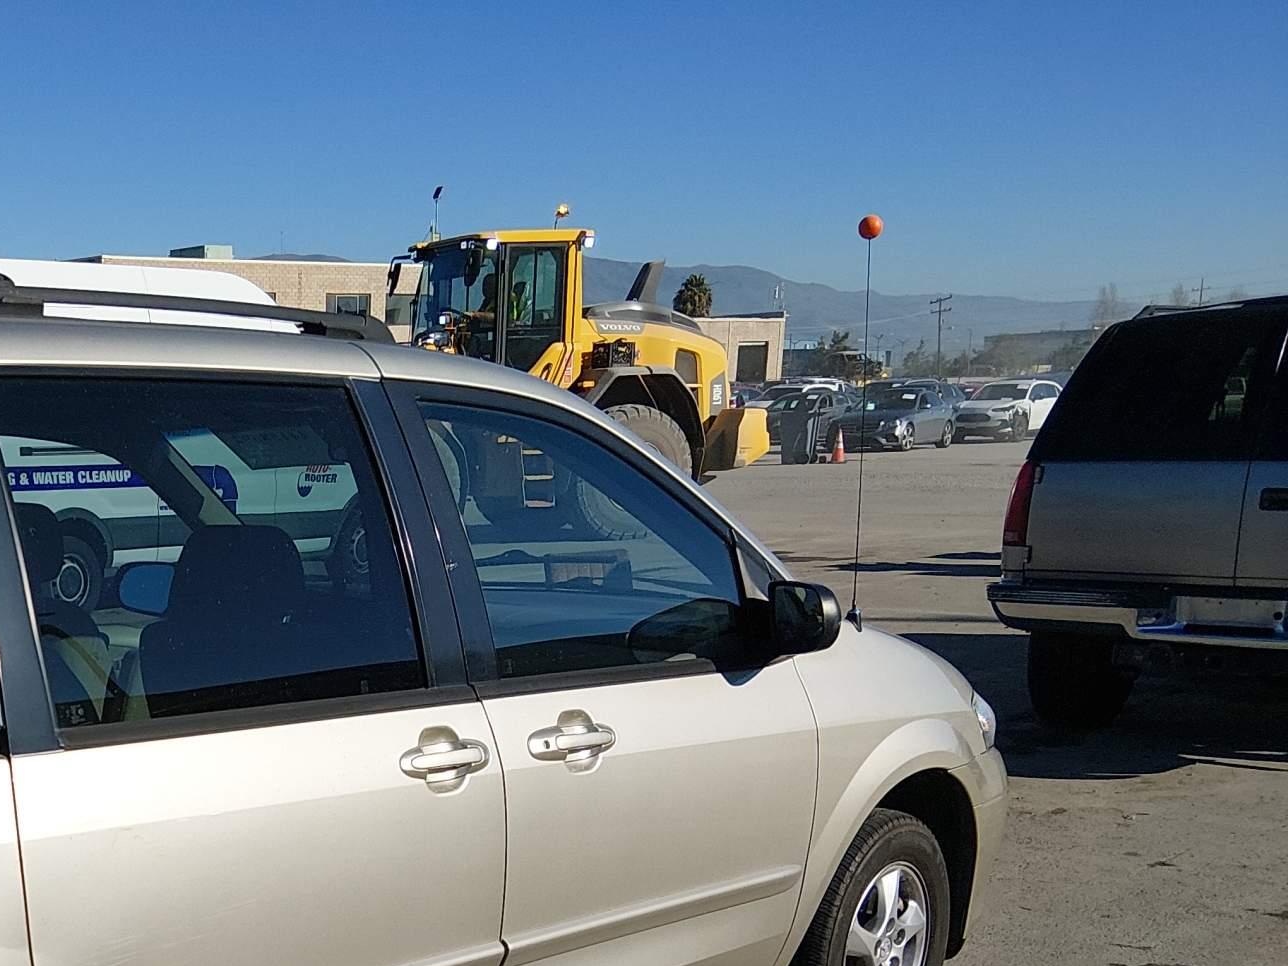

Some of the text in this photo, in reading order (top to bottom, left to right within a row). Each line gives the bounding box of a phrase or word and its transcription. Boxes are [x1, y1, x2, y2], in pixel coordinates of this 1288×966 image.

[712, 384, 722, 405] L90H
[20, 473, 29, 485] &
[32, 471, 75, 485] WATER
[77, 469, 132, 484] CLEANUP
[304, 473, 338, 484] ROOTER
